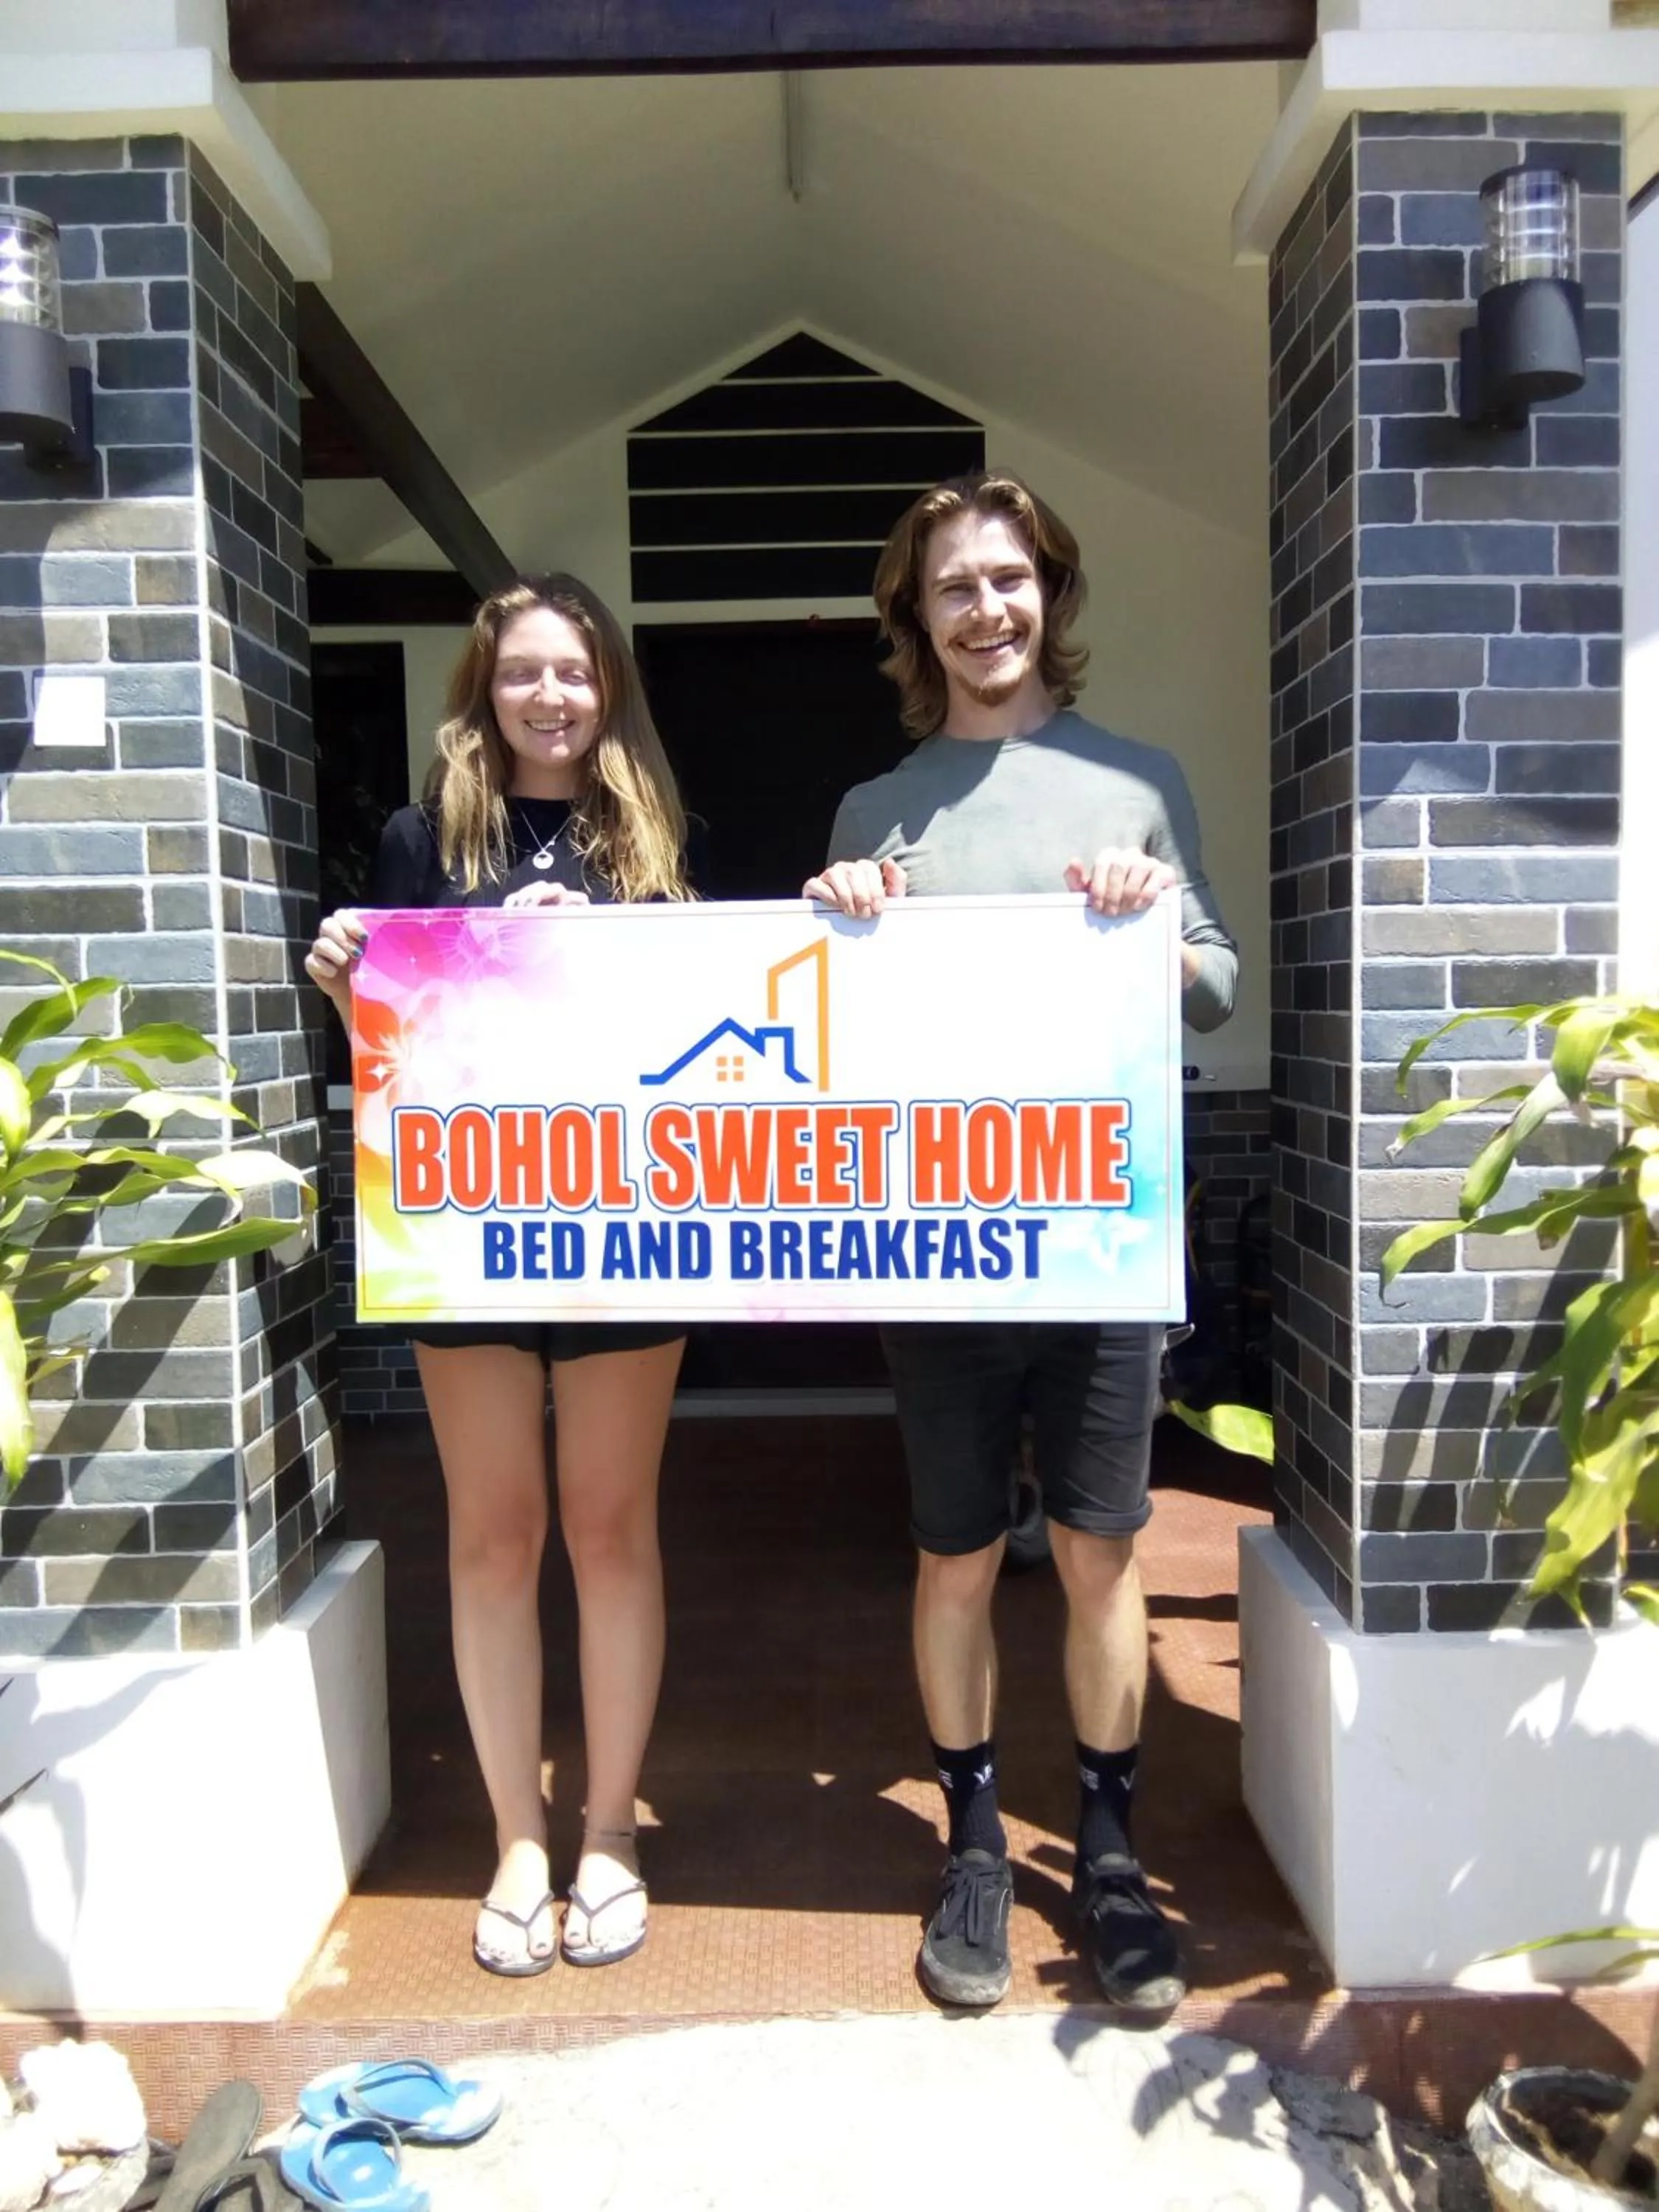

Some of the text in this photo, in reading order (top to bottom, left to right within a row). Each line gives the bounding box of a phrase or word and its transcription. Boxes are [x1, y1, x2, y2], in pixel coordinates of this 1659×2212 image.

[396, 1103, 1127, 1208] BOHOL SWEET HOME
[481, 1218, 1048, 1281] BED AND BREAKFAST
